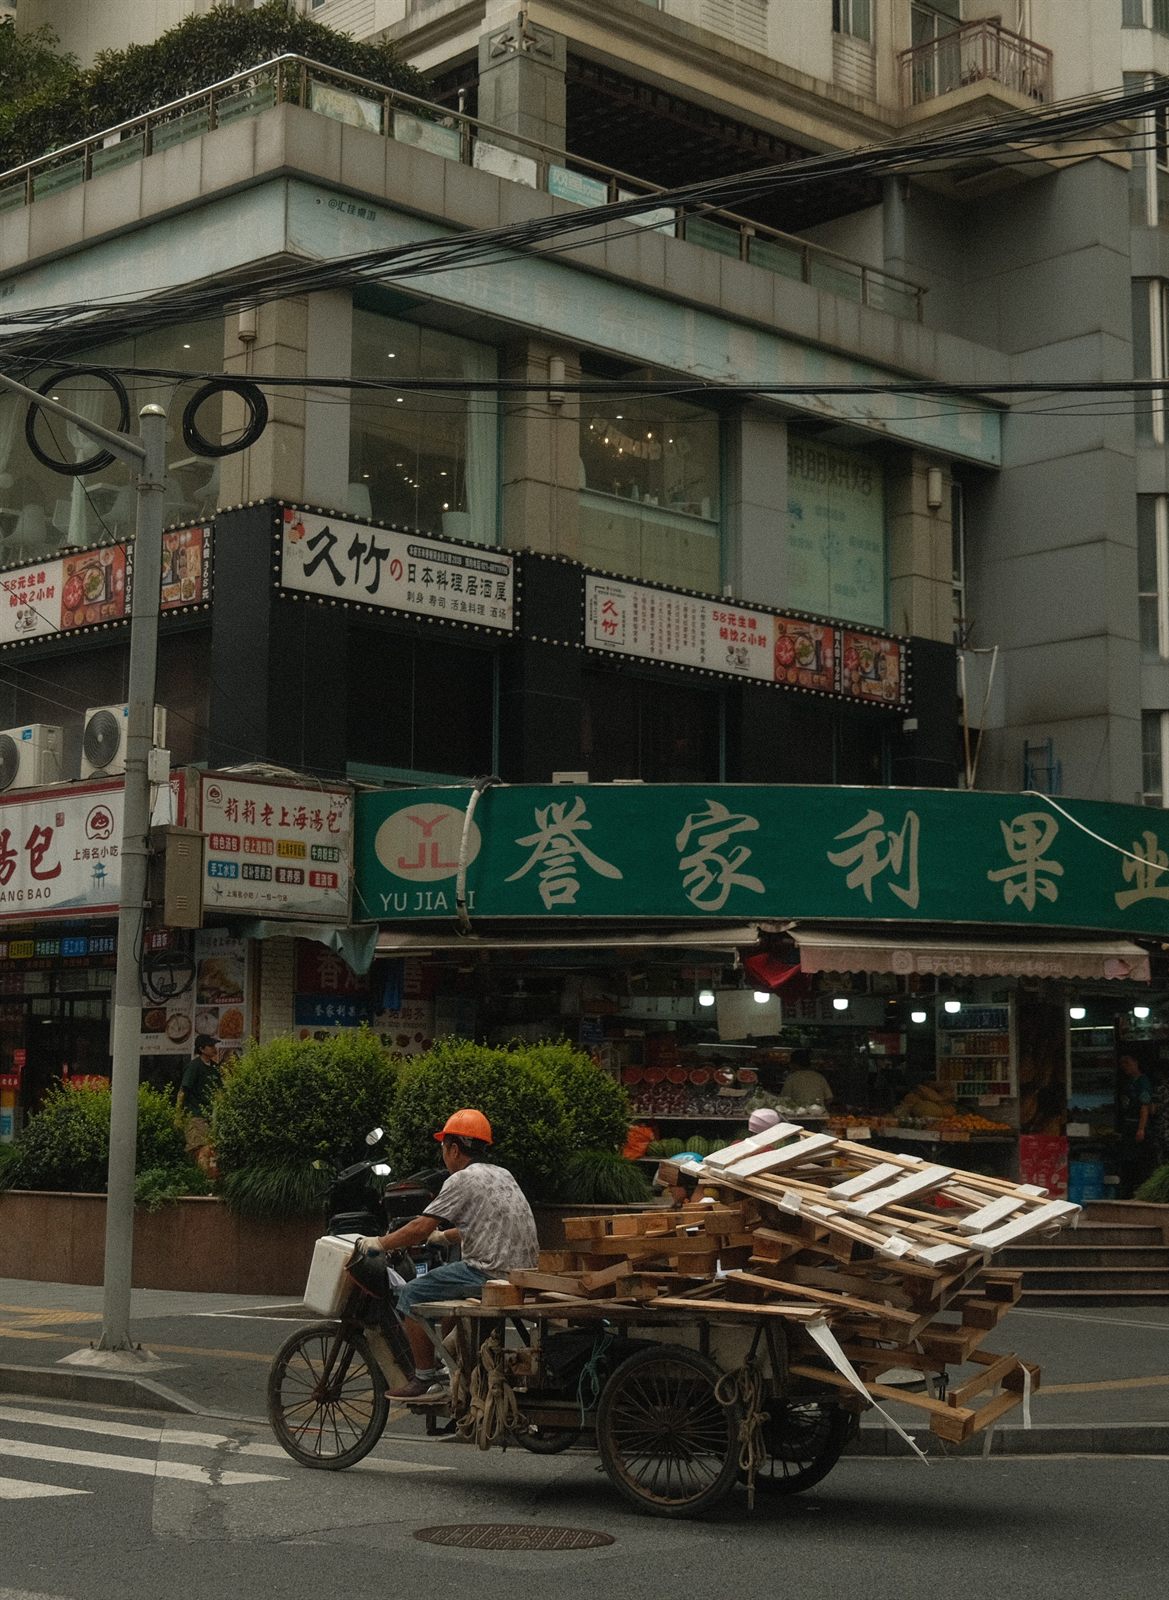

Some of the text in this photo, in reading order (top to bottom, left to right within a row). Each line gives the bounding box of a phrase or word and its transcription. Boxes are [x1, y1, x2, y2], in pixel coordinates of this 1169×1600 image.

[407, 563, 507, 602] 日本料理居酒屋
[601, 600, 618, 636] 久竹
[73, 845, 119, 861] 上海名小吃
[398, 843, 461, 869] JL
[27, 887, 51, 900] BAO
[380, 892, 407, 911] YU
[413, 891, 448, 910] JIA
